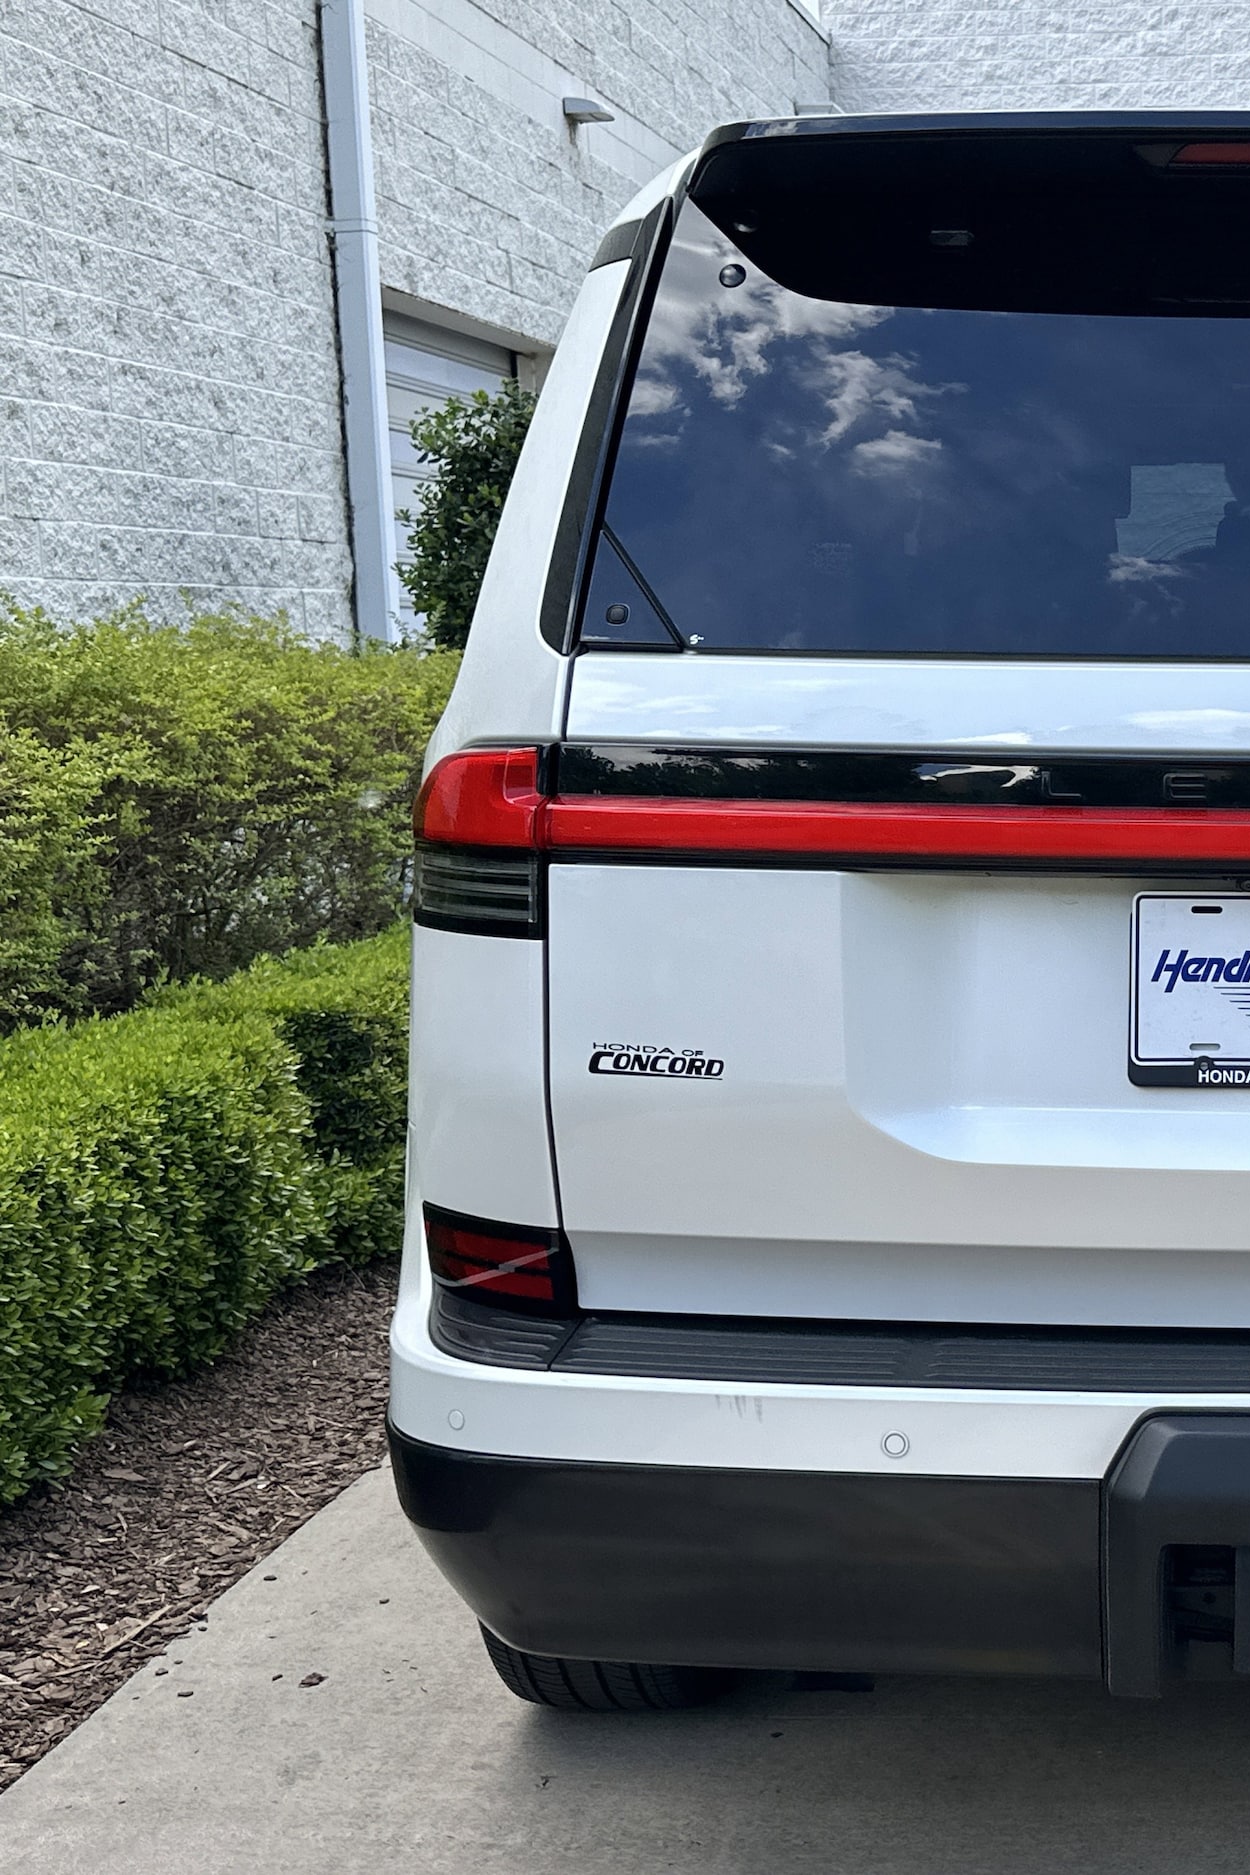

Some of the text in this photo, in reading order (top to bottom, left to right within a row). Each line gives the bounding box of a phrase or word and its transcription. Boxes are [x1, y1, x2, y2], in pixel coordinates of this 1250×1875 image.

[592, 1042, 704, 1057] HONDA OF
[588, 1051, 724, 1077] CONCORD
